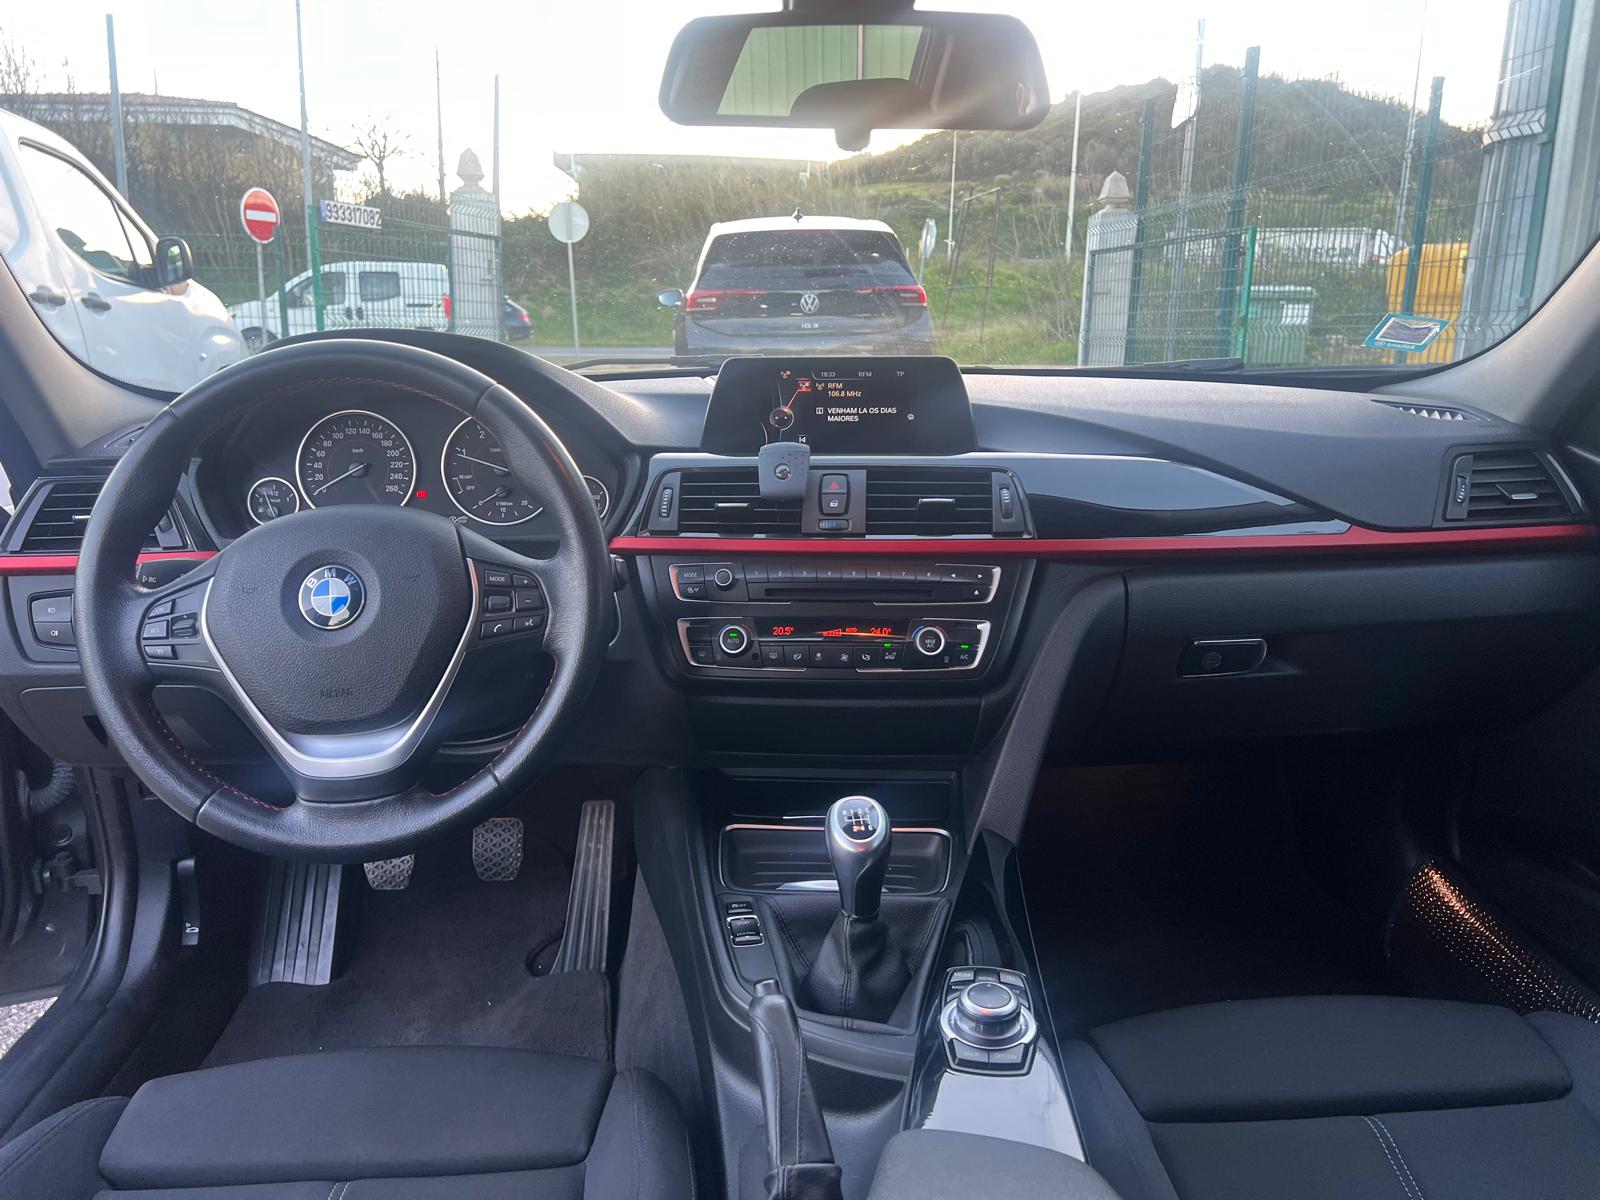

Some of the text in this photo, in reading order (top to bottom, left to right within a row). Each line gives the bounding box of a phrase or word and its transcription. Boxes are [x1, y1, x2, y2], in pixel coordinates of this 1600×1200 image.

[326, 203, 382, 227] 933317082
[827, 407, 897, 415] VENHAM LA OS DIAS
[346, 427, 357, 436] 120
[359, 427, 371, 436] 140
[479, 430, 486, 439] 2
[332, 432, 344, 440] 100
[372, 432, 384, 440] 160
[323, 440, 332, 448] 80
[381, 440, 393, 448] 180
[316, 450, 326, 458] 60
[387, 450, 400, 458] 200
[313, 461, 323, 469] 40
[390, 461, 403, 469] 220
[390, 473, 403, 481] 240
[385, 485, 399, 493] 260
[306, 568, 357, 589] BMW
